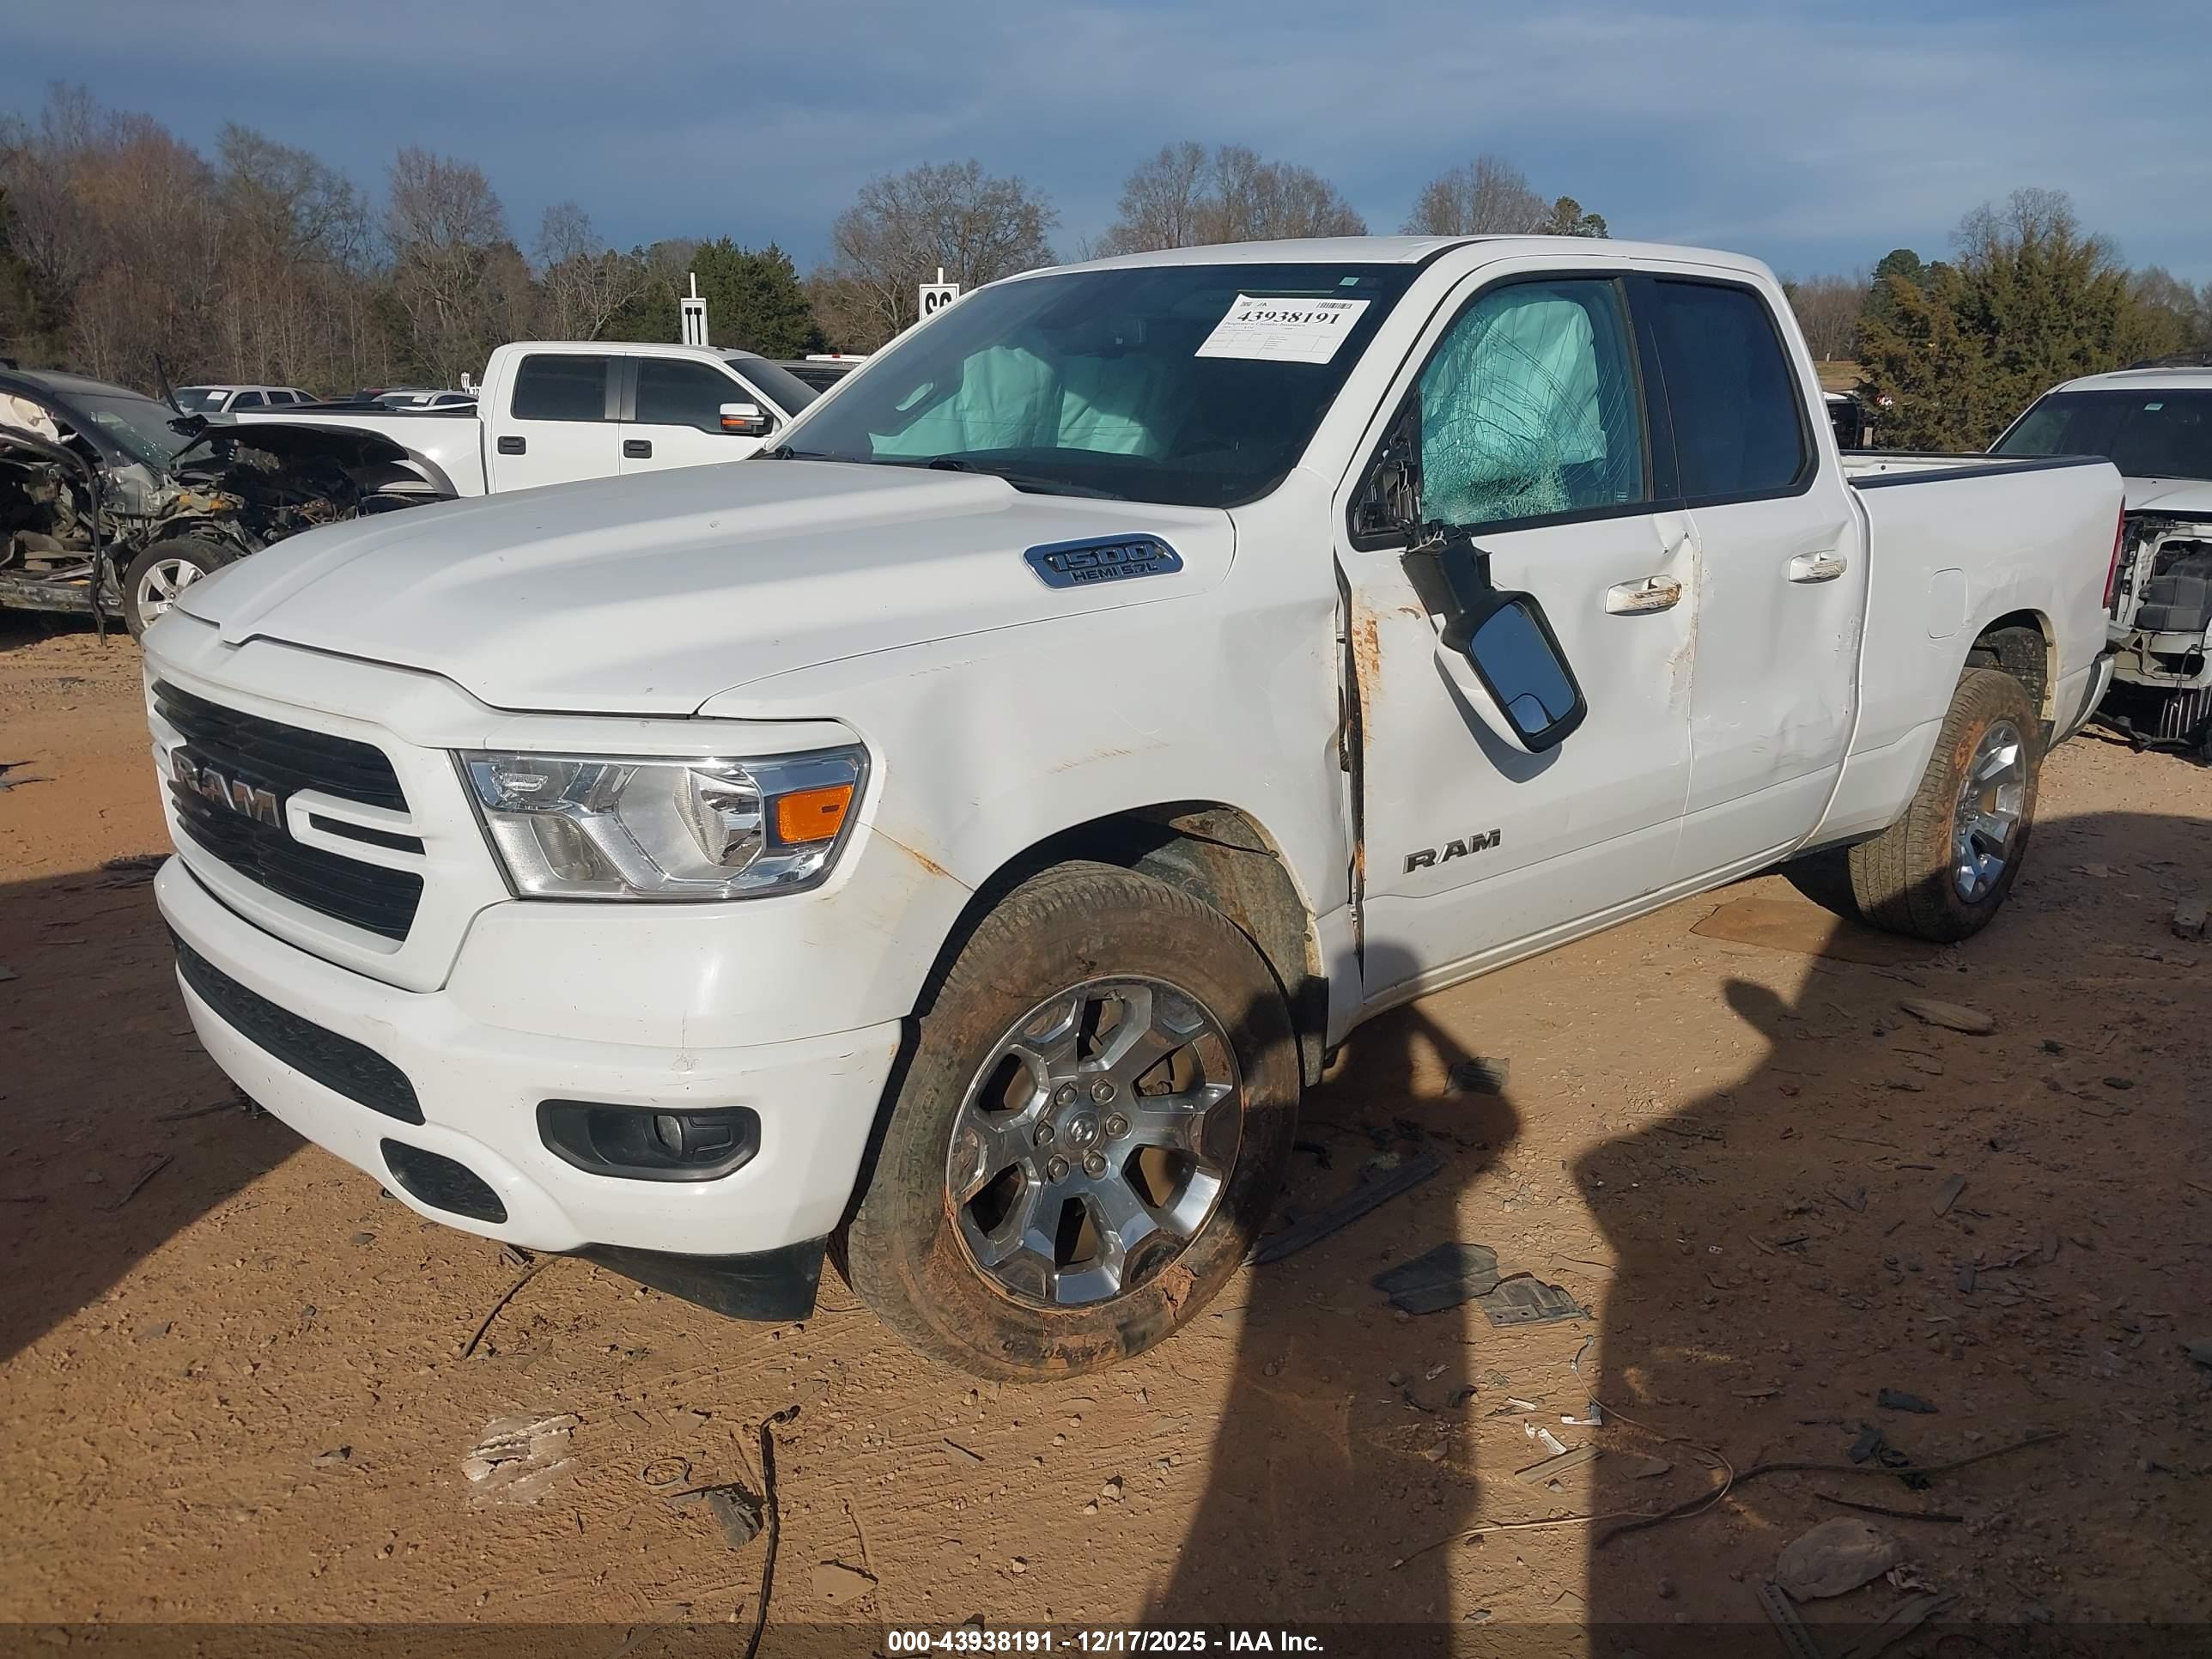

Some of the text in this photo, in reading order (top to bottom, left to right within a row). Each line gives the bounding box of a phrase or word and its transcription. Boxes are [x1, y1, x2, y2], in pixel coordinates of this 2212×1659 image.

[1237, 310, 1340, 325] 43938191
[1045, 541, 1156, 573] 1500
[1072, 563, 1159, 583] HEMI 5.7L
[171, 749, 282, 830] RAM
[1402, 828, 1502, 875] RAM
